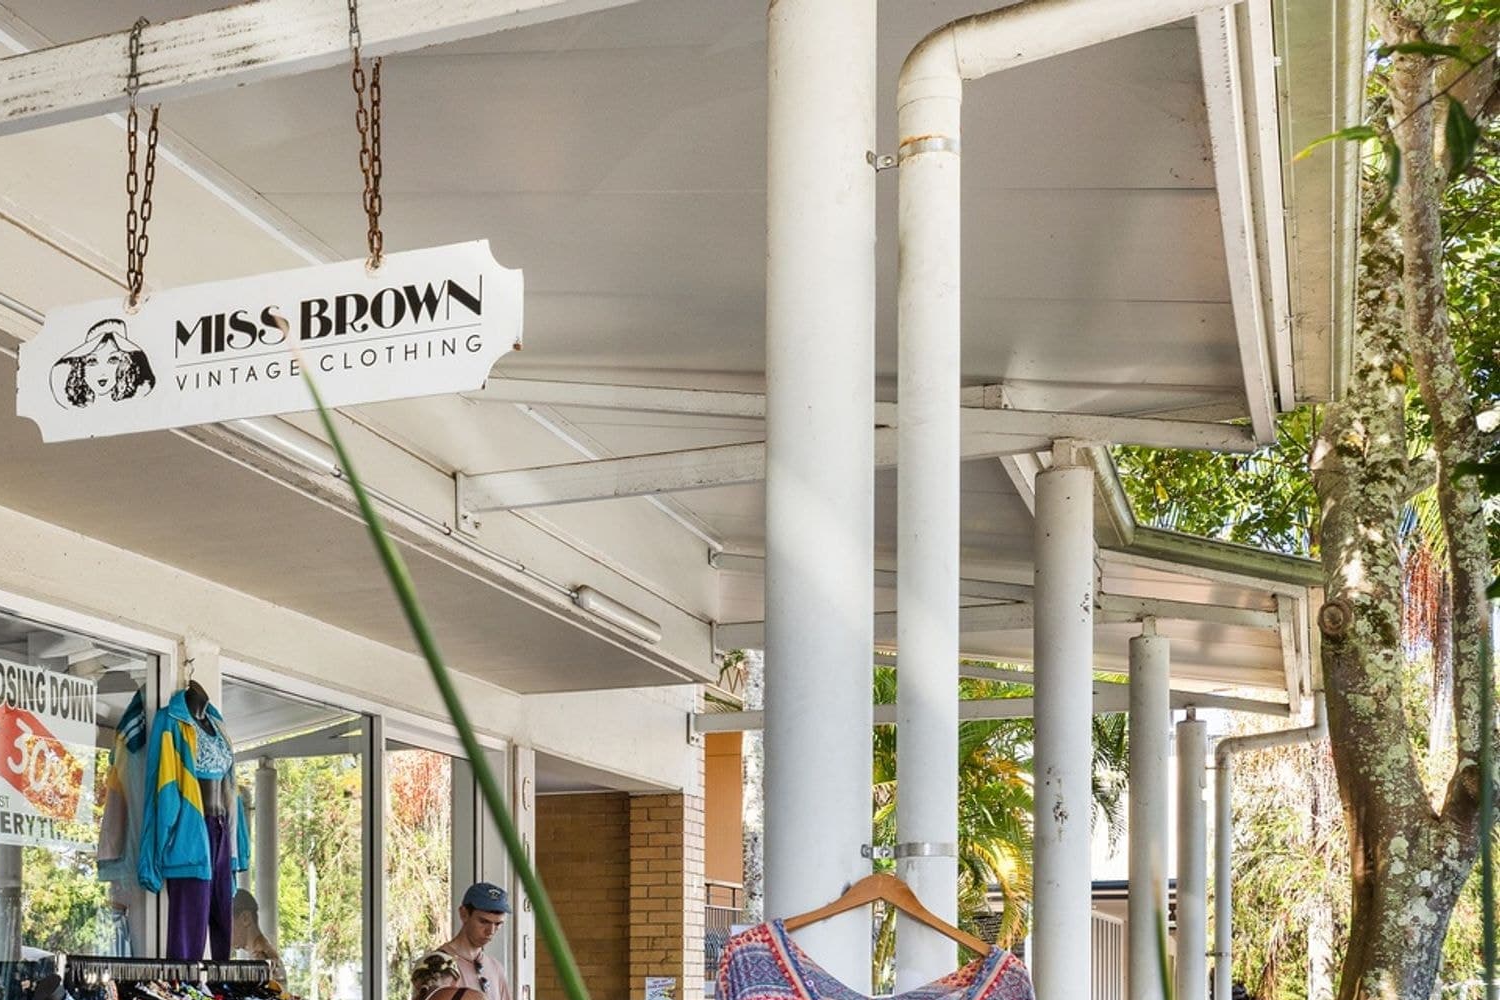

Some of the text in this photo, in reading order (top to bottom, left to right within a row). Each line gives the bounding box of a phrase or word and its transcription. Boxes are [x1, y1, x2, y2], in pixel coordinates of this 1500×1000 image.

[174, 274, 482, 358] MISS BROWN
[176, 333, 483, 391] VINTAGE CLOTHING
[50, 675, 94, 724] DOWN
